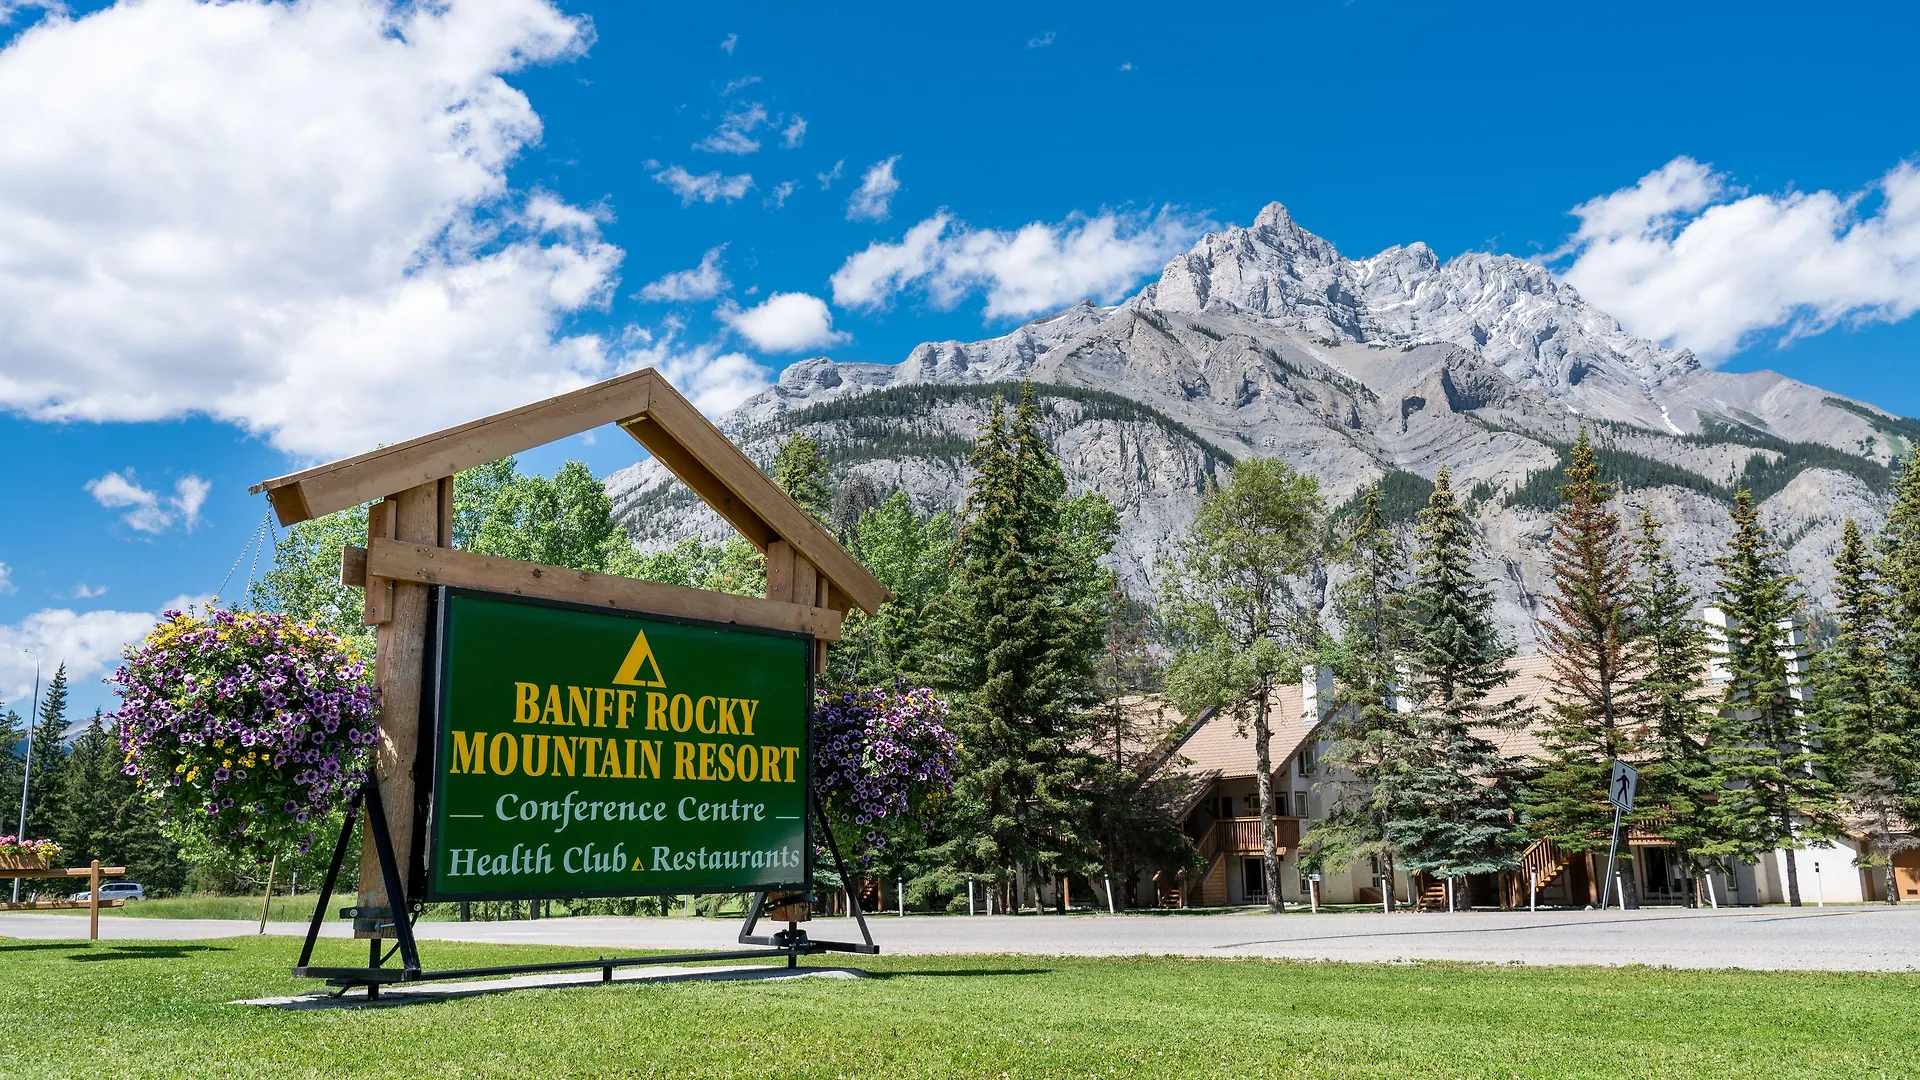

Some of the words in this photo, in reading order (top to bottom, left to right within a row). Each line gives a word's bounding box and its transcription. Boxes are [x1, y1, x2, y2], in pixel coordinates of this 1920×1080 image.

[513, 681, 637, 730] BANFF
[645, 690, 759, 736] ROCKY
[449, 730, 663, 779] MOUNTAIN
[673, 741, 800, 783] RESORT
[495, 790, 668, 833] Conference
[677, 796, 766, 822] Centre
[447, 842, 555, 876] Health
[563, 842, 627, 873] Club
[650, 845, 800, 872] Restaurants
